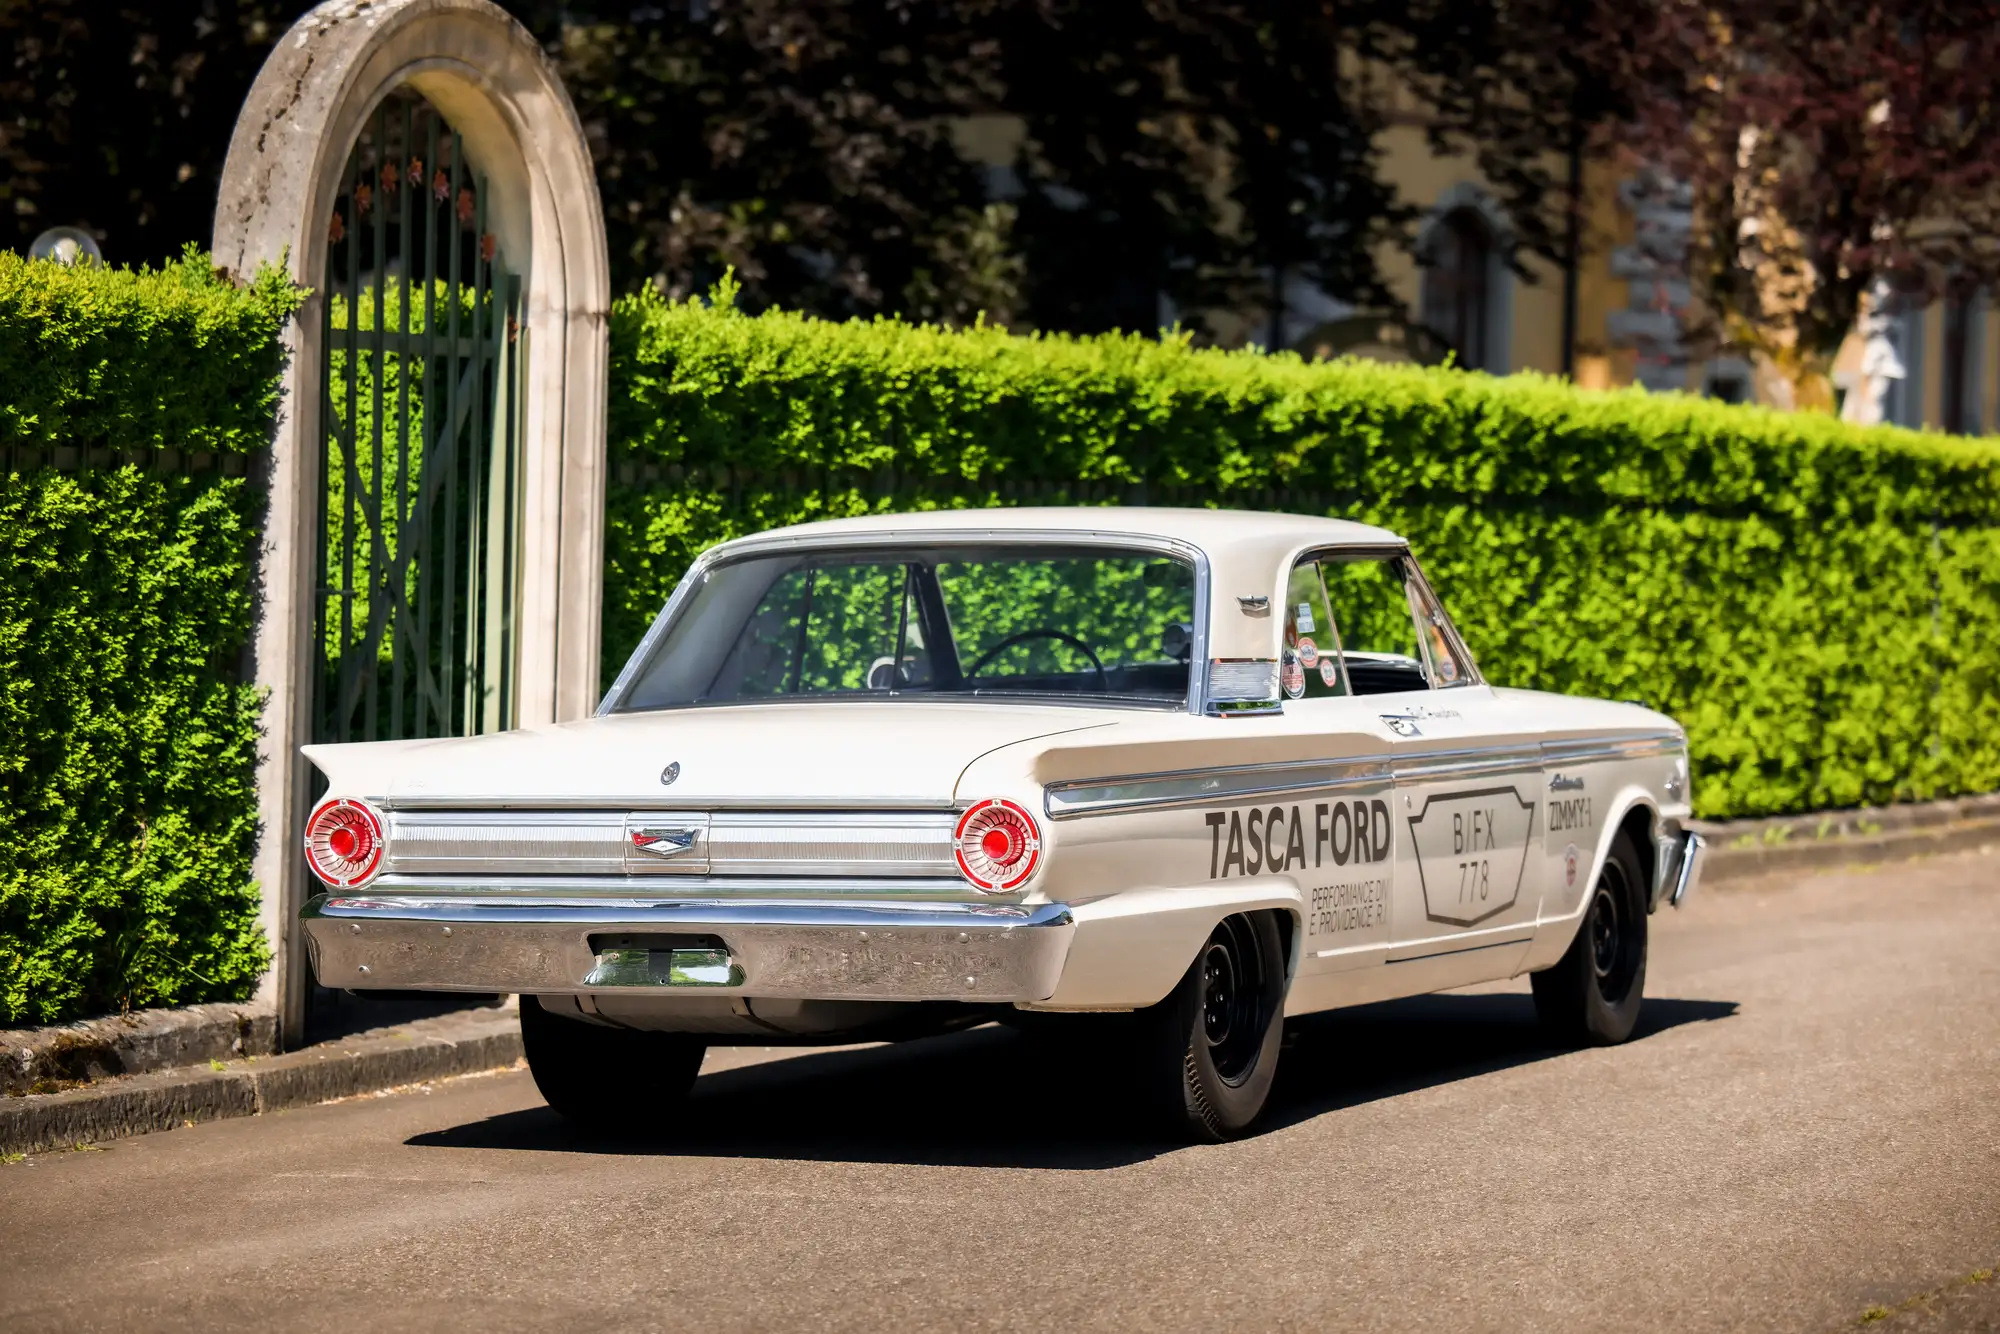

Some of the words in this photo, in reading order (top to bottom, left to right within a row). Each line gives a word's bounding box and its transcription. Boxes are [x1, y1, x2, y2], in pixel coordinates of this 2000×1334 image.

[1205, 805, 1306, 879] TASCA
[1315, 800, 1390, 868] FORD
[1453, 809, 1495, 855] B/FX
[1311, 881, 1374, 910] PERFORMANCE
[1459, 860, 1489, 904] 778
